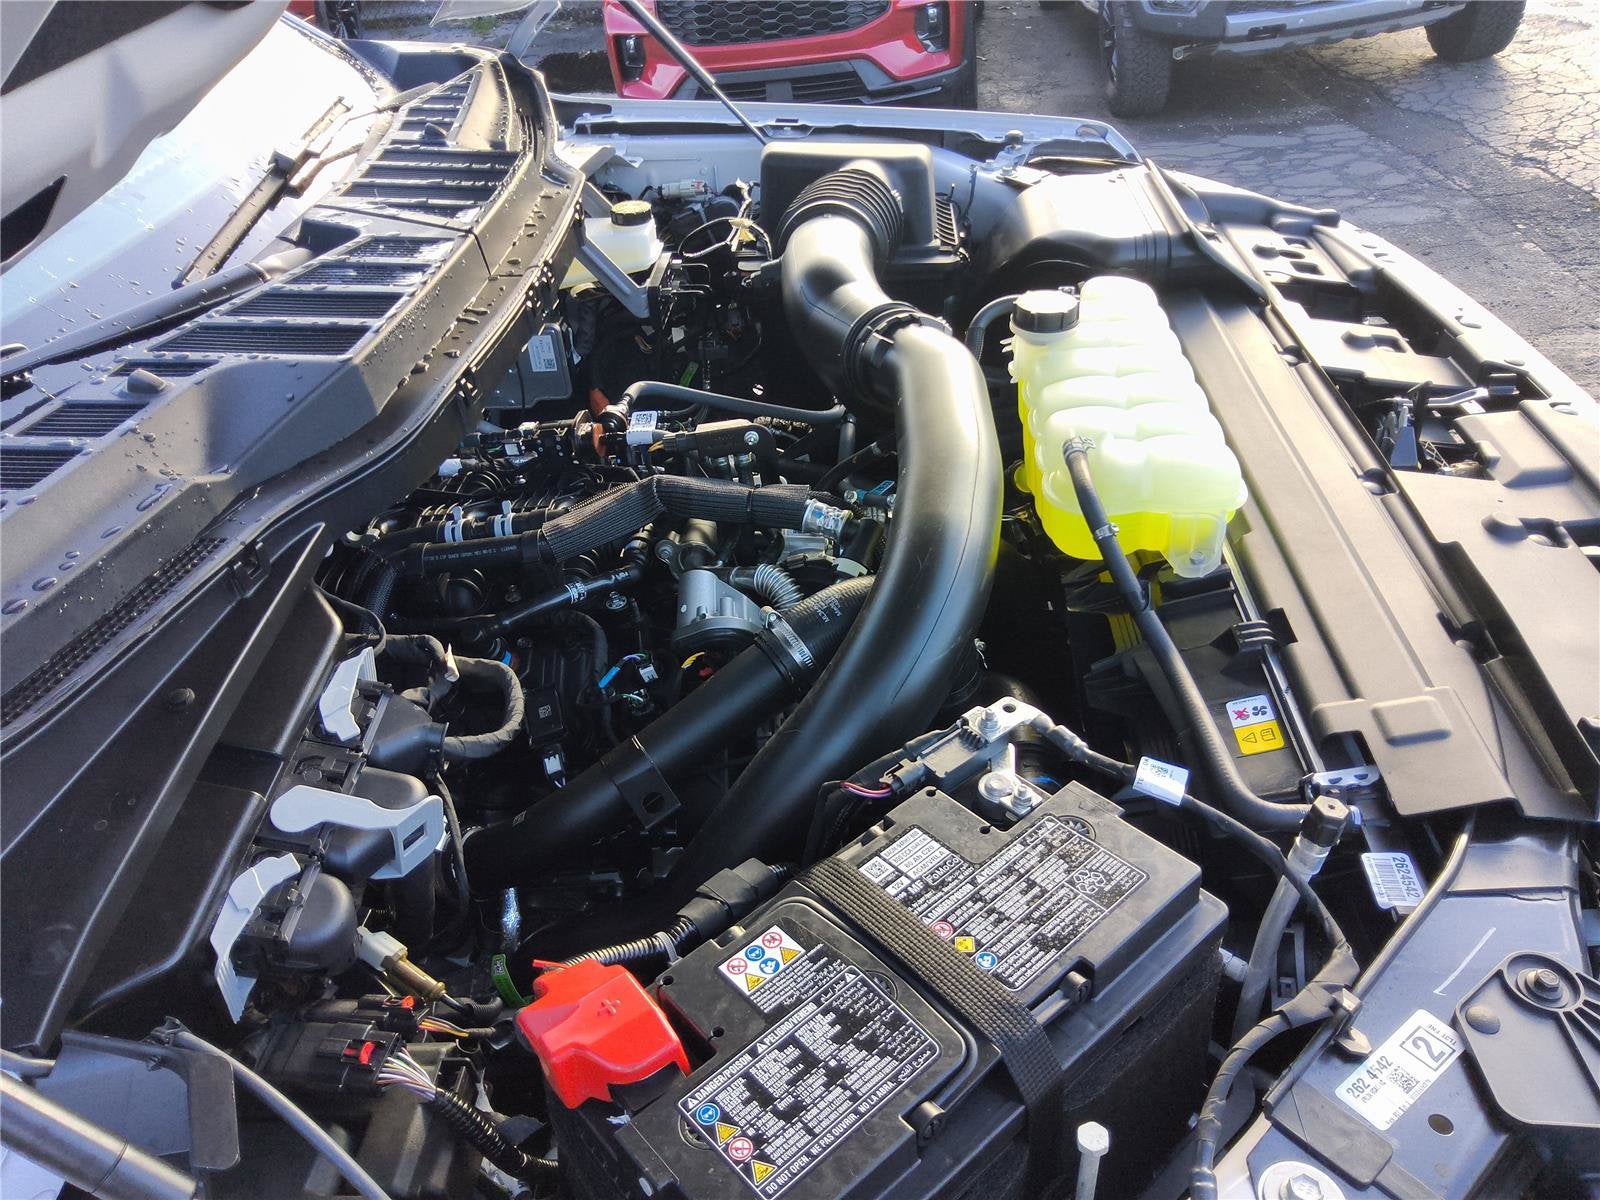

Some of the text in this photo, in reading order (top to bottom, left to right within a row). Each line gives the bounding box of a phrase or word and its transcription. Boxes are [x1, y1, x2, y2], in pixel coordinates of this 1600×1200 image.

[924, 855, 959, 883] FoMoCo
[1392, 856, 1421, 898] 2624542
[891, 879, 905, 890] 12V
[906, 879, 925, 894] MF
[763, 1001, 817, 1046] PELIGRO/VENENO
[1412, 1036, 1446, 1063] 2
[694, 1052, 752, 1101] DANGER/POISON
[1346, 1078, 1370, 1099] 262
[765, 1078, 896, 1194] DO NOT OPEN. NE PAS OUVRIR. NO LA ABRA.
